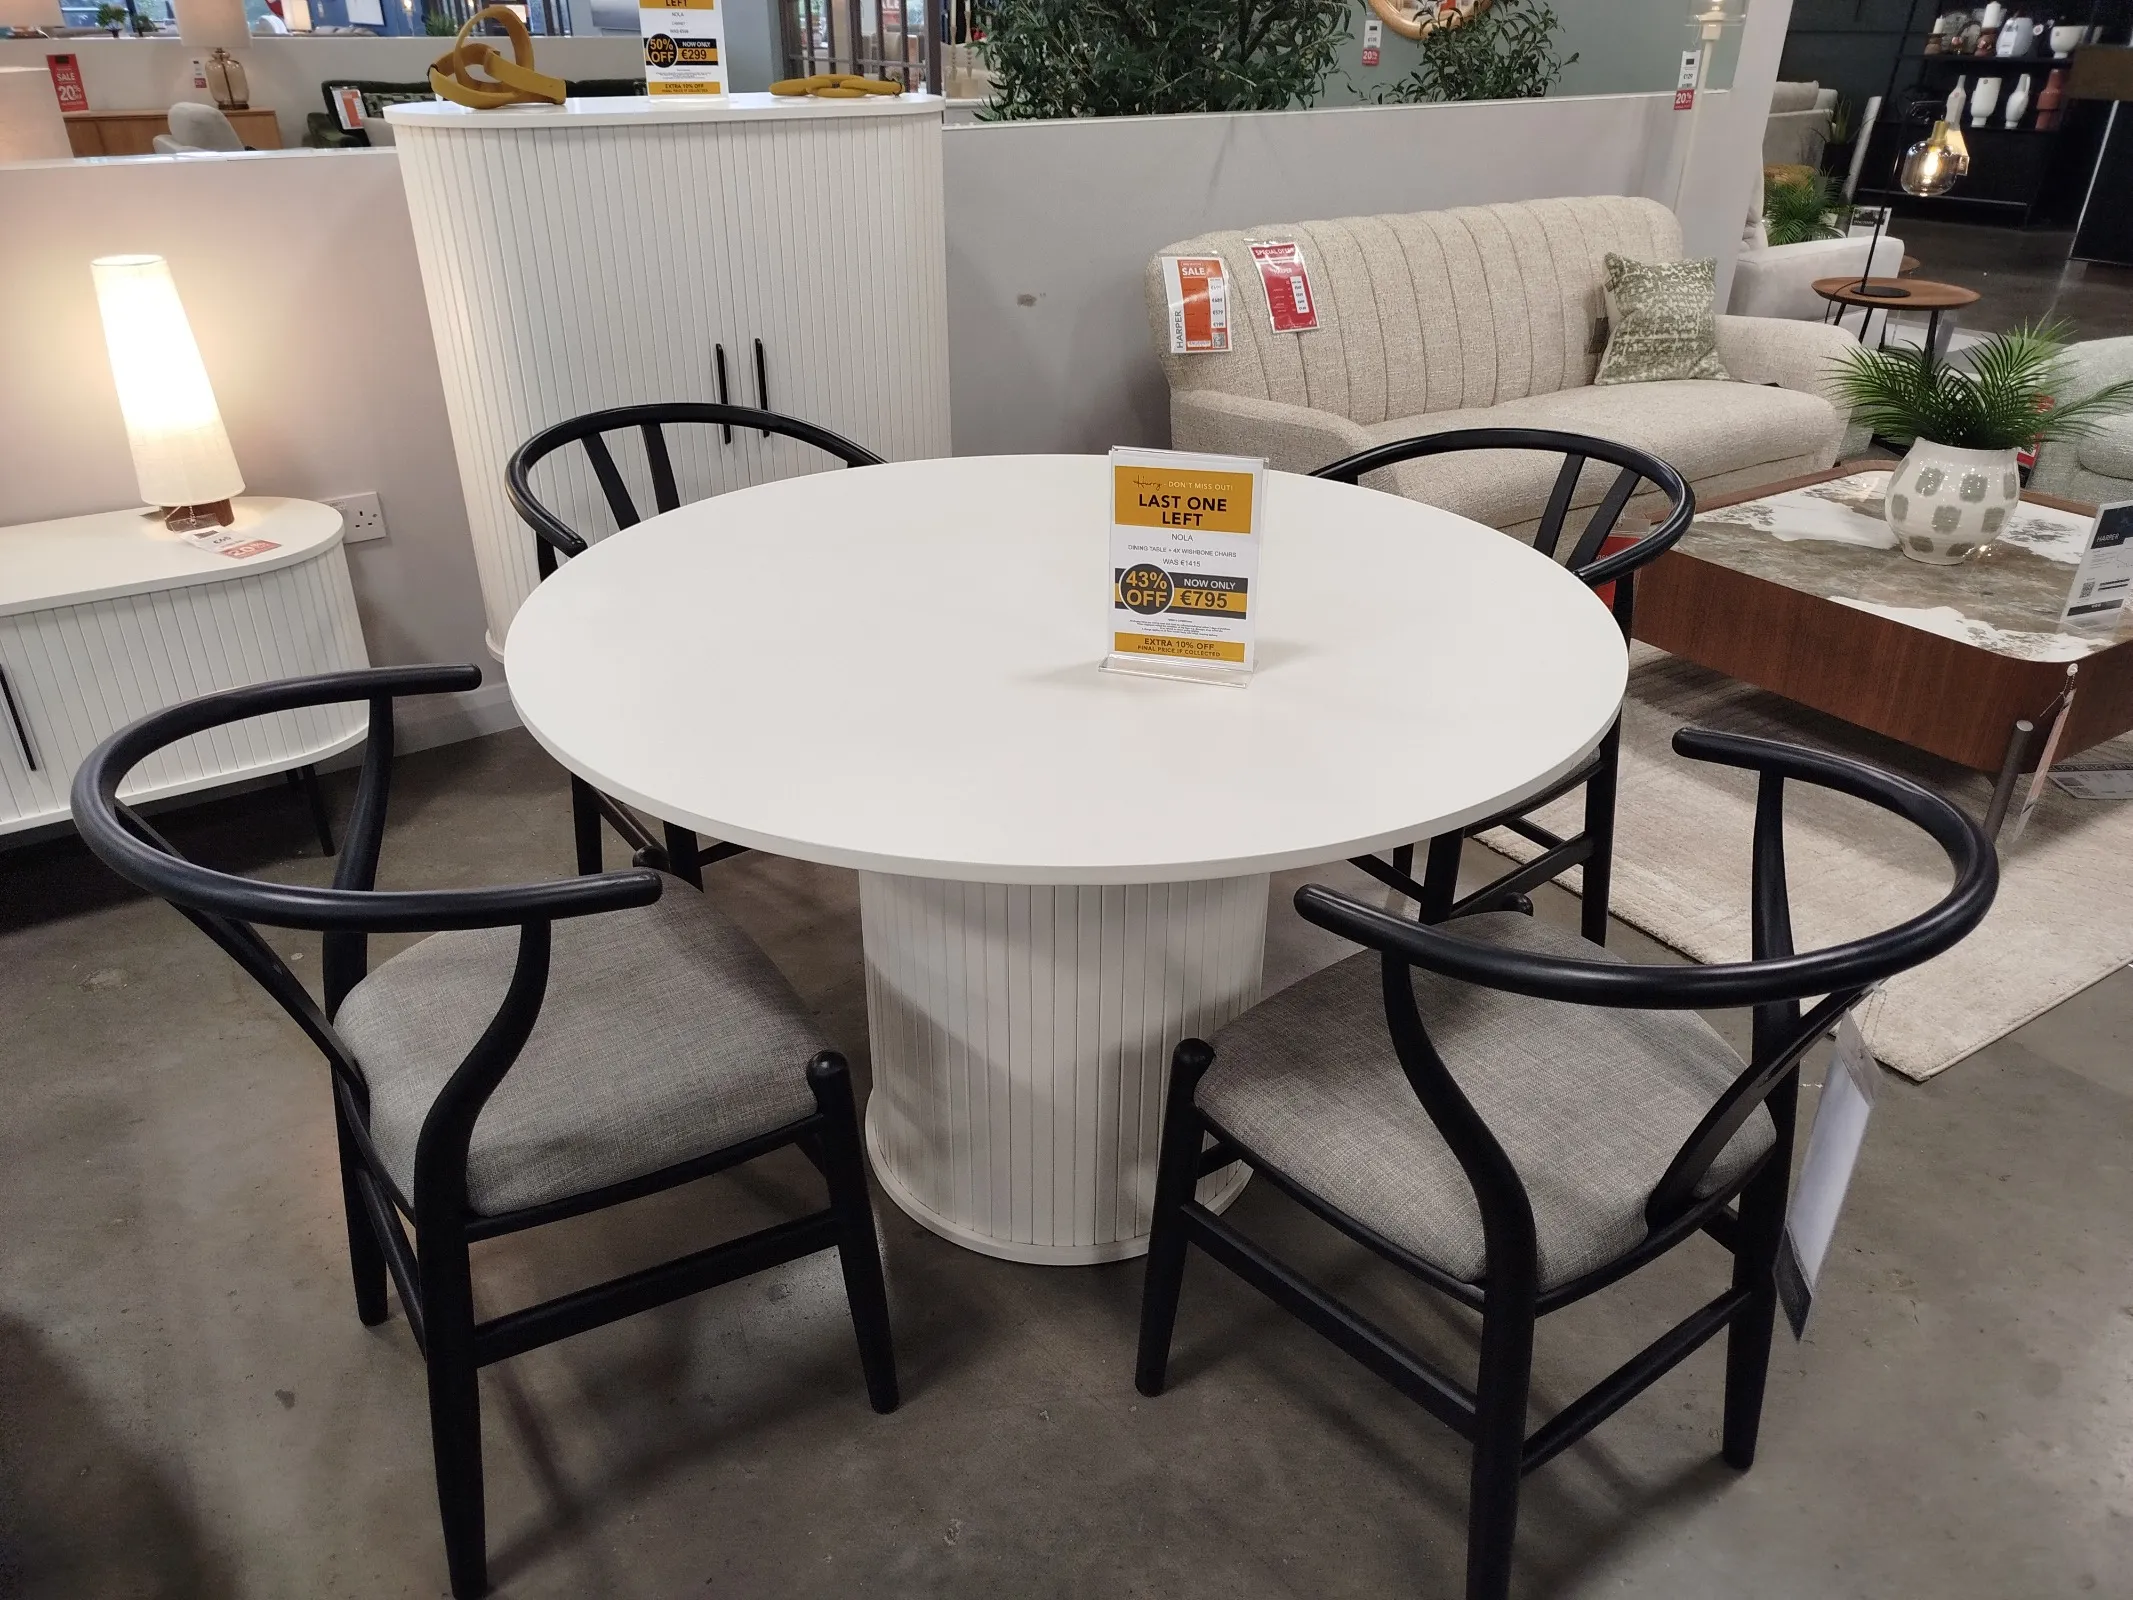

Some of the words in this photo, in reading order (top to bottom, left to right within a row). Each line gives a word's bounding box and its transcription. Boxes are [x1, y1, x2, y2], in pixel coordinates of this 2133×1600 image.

[650, 38, 674, 50] 50%
[651, 51, 675, 63] OFF
[681, 49, 707, 60] €299
[56, 73, 76, 82] SALE
[1675, 92, 1692, 104] 20%
[1255, 248, 1277, 256] SPECIAL
[1181, 267, 1206, 276] SALE
[1174, 310, 1184, 349] HARPER
[1133, 475, 1162, 491] Hurry
[1139, 493, 1181, 509] LAST
[1187, 496, 1227, 512] ONE
[1162, 511, 1203, 527] LEFT
[1171, 533, 1194, 542] NOLA
[1128, 544, 1149, 552] DINING
[1181, 549, 1214, 557] WISHBONE
[1214, 550, 1237, 558] CHAIRS
[1163, 558, 1179, 566] WAS
[1180, 559, 1201, 567] €1415
[1126, 570, 1168, 590] 43%
[1183, 578, 1208, 588] NOW
[1210, 580, 1236, 590] ONLY
[1126, 589, 1168, 608] OFF
[1180, 589, 1228, 609] €795
[1144, 637, 1172, 647] EXTRA
[1175, 640, 1194, 649] 10%
[1196, 642, 1215, 651] OFF
[1137, 644, 1156, 652] FINAL
[1157, 646, 1175, 654] PRICE
[1184, 649, 1221, 657] COLLECTED
